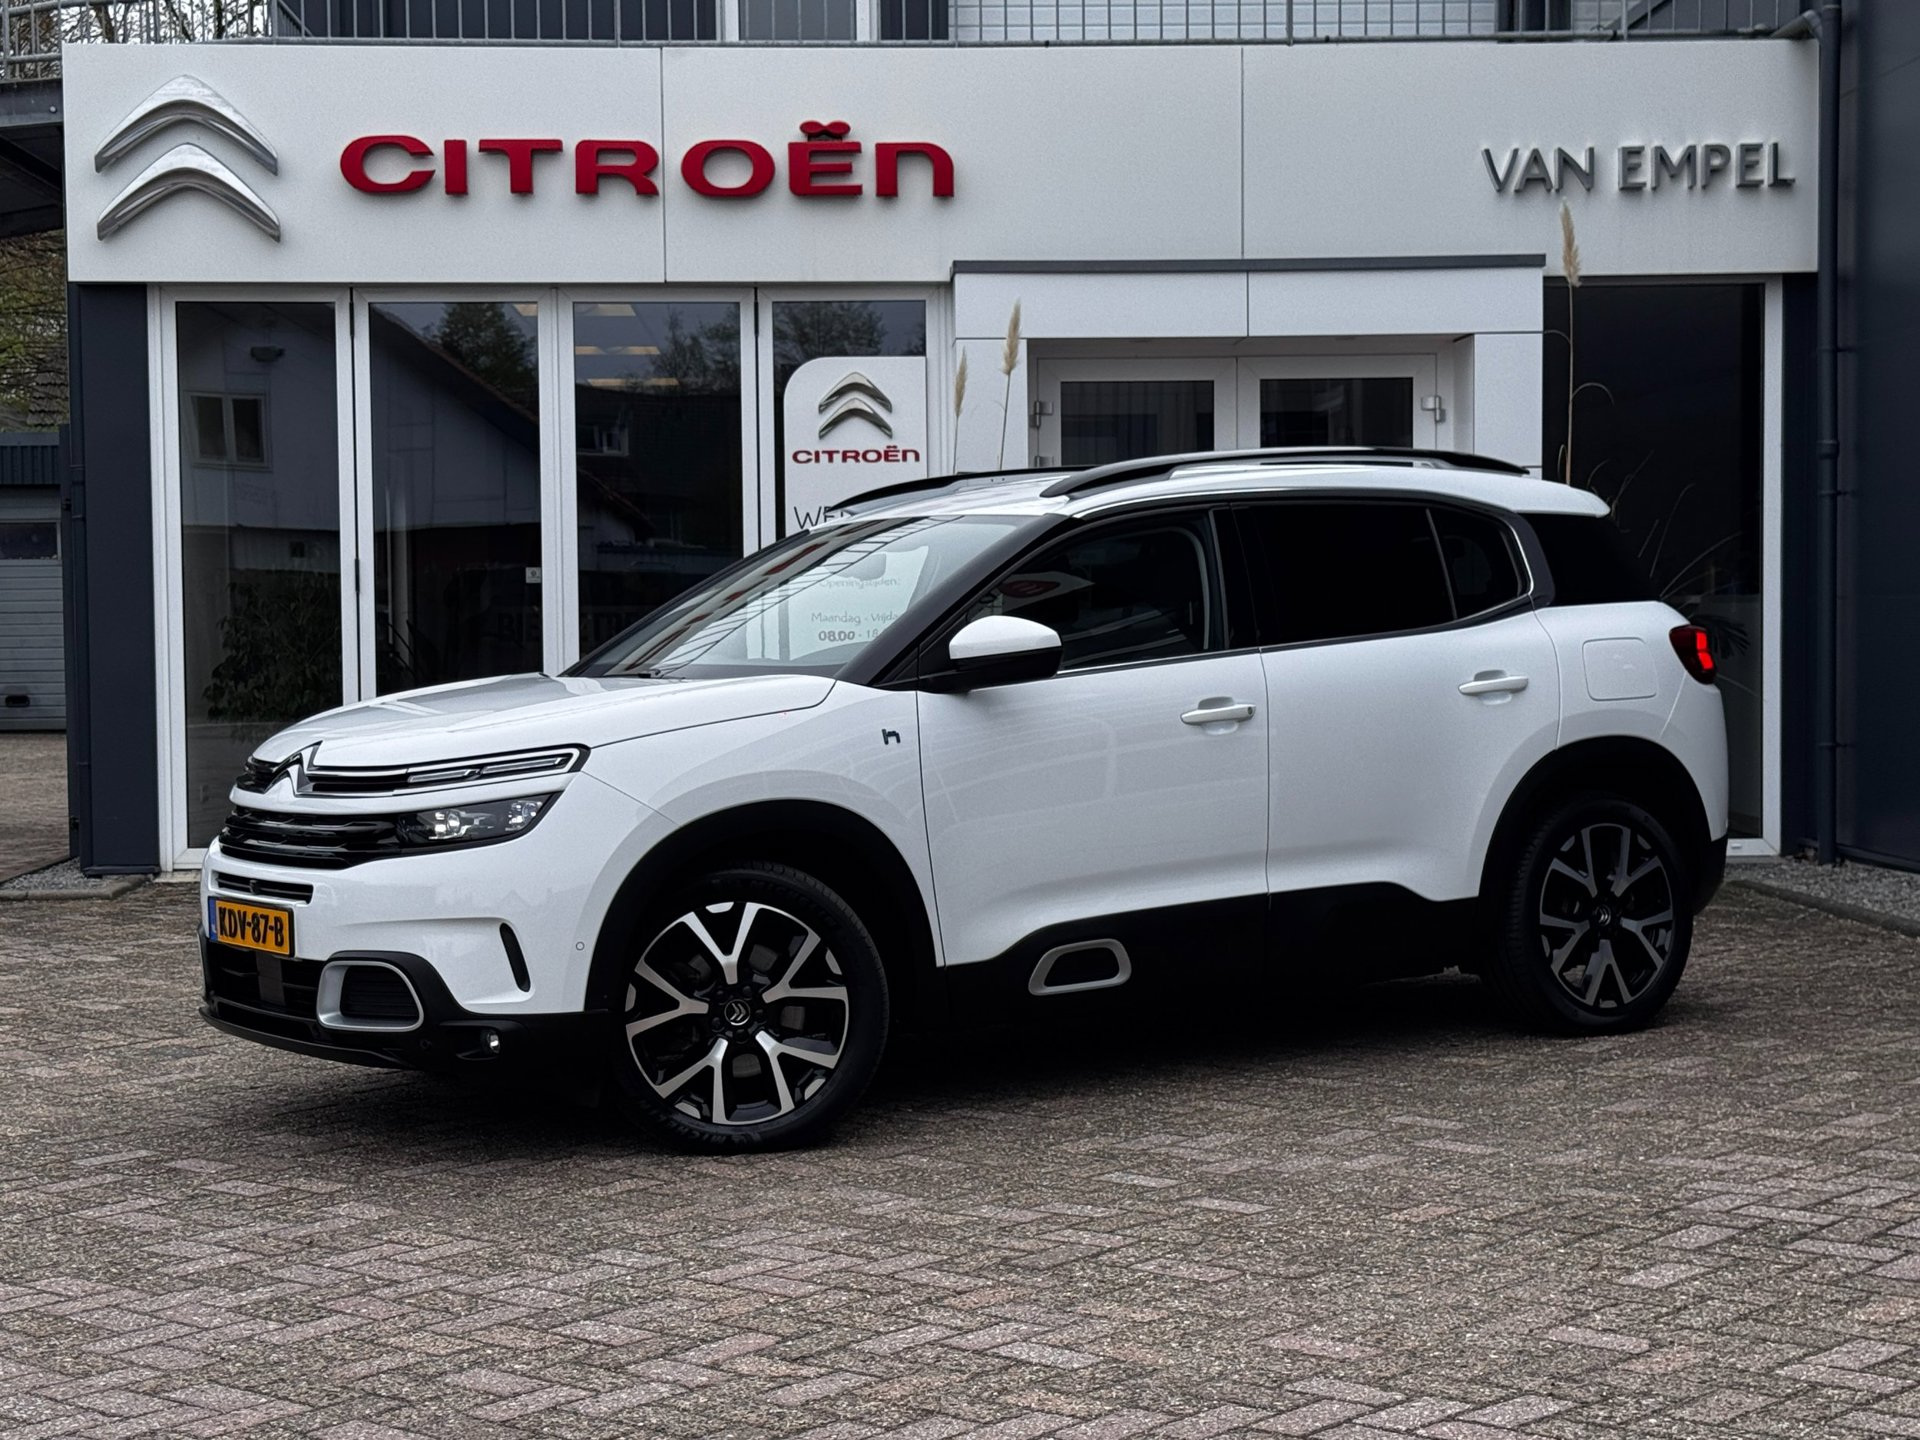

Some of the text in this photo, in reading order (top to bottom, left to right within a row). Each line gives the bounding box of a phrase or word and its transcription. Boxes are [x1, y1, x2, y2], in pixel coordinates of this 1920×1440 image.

[1481, 142, 1796, 193] VAN EMPEL
[811, 610, 861, 626] Maandag
[818, 630, 856, 642] 08.00
[218, 907, 284, 947] KDV-87-B
